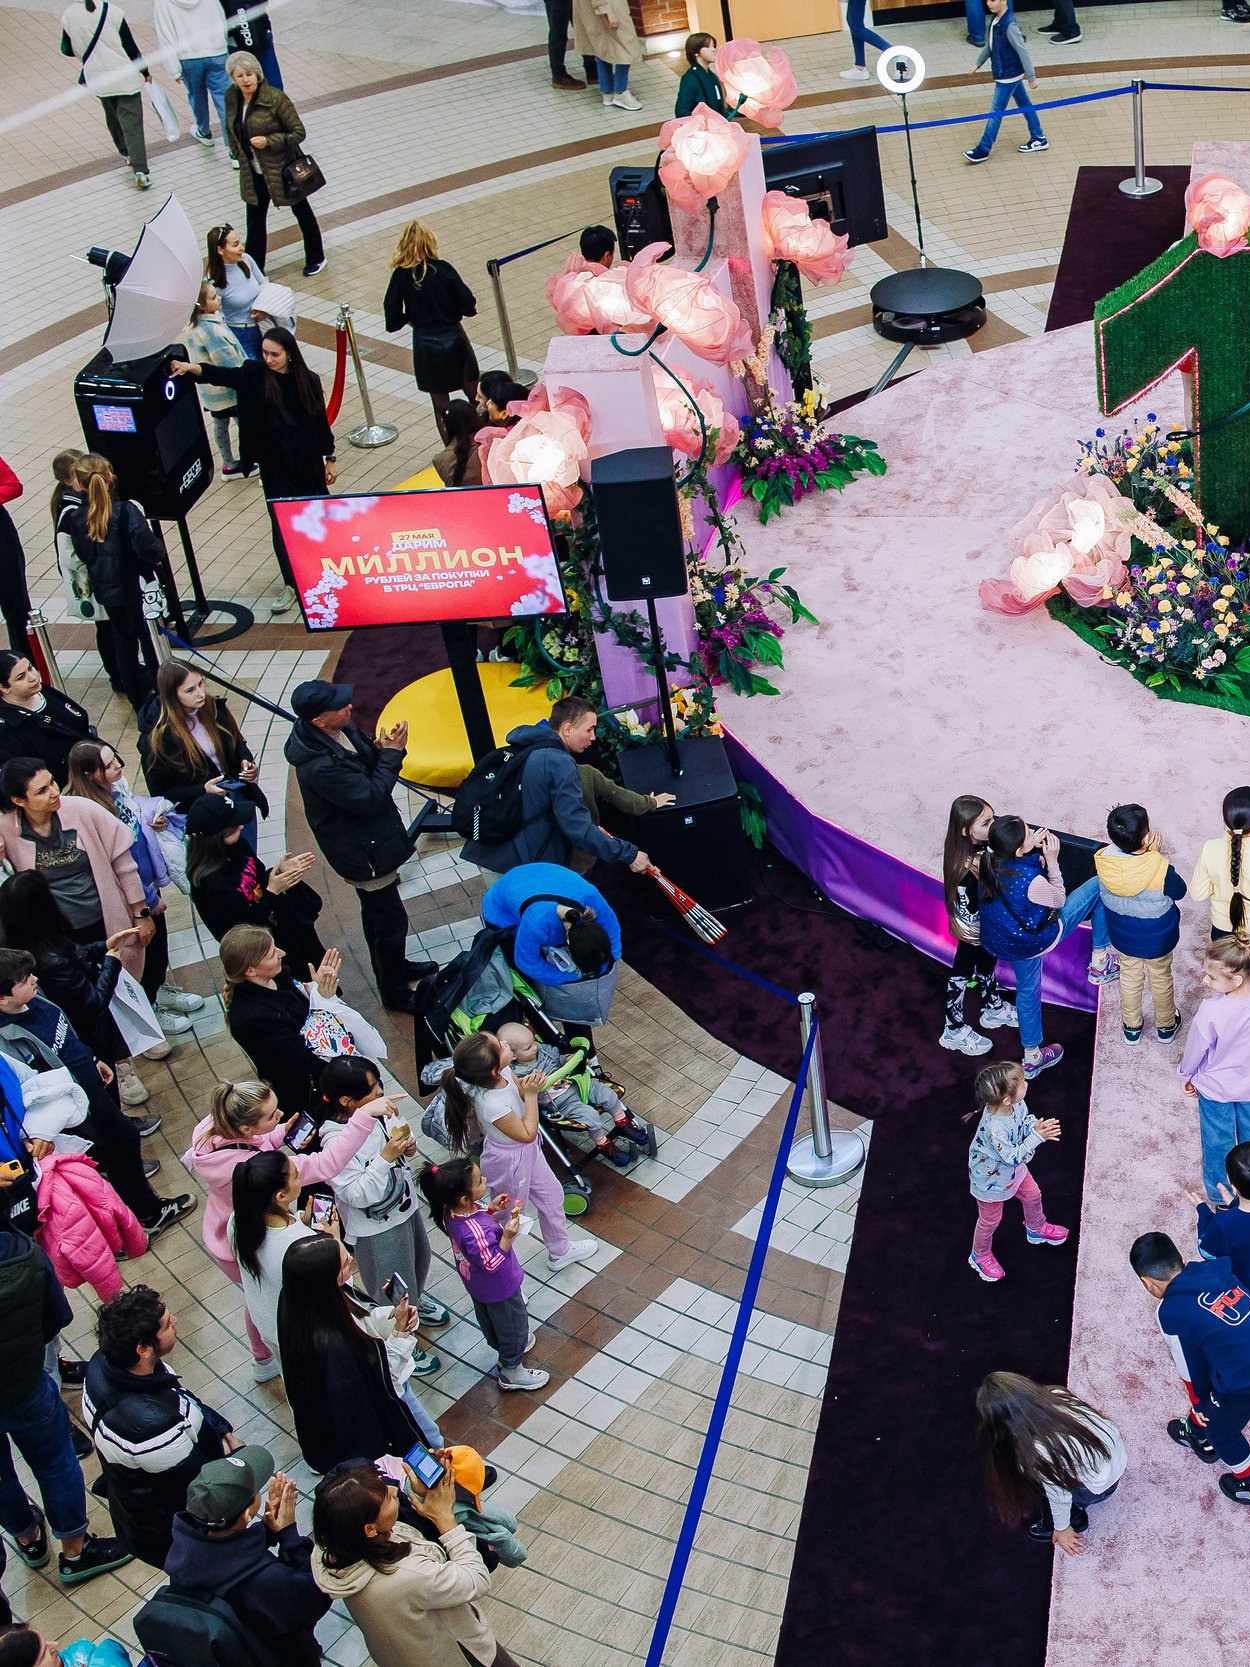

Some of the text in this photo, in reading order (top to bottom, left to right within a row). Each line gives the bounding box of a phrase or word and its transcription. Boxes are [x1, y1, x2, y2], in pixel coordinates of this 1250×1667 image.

[237, 8, 253, 46] adidas
[391, 538, 446, 552] ДАРИМ
[320, 545, 524, 576] МИЛЛИОН
[364, 569, 490, 584] РУБЛЕЙ ЗА ПОКУПКИ
[384, 585, 391, 593] В
[393, 583, 418, 593] ТРЦ
[1210, 1287, 1245, 1318] FILA
